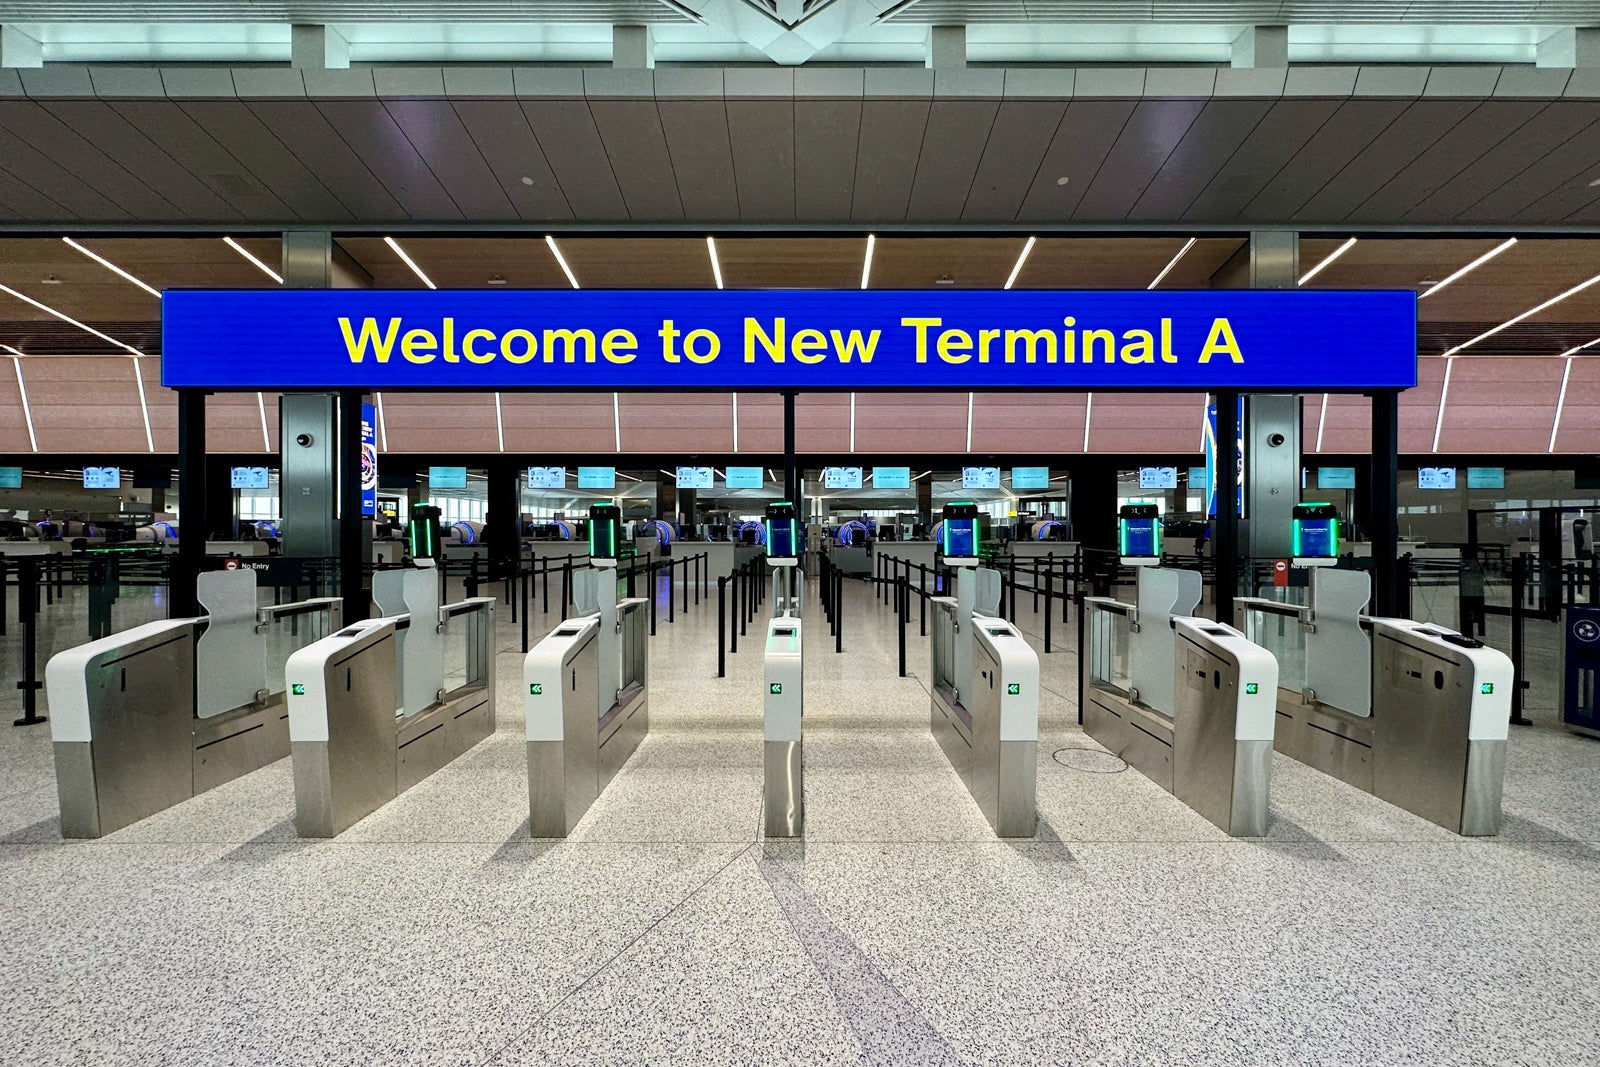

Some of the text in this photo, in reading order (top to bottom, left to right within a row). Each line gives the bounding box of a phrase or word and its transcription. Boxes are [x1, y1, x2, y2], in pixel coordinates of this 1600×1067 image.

[338, 316, 1244, 365] Welcome to New Terminal A
